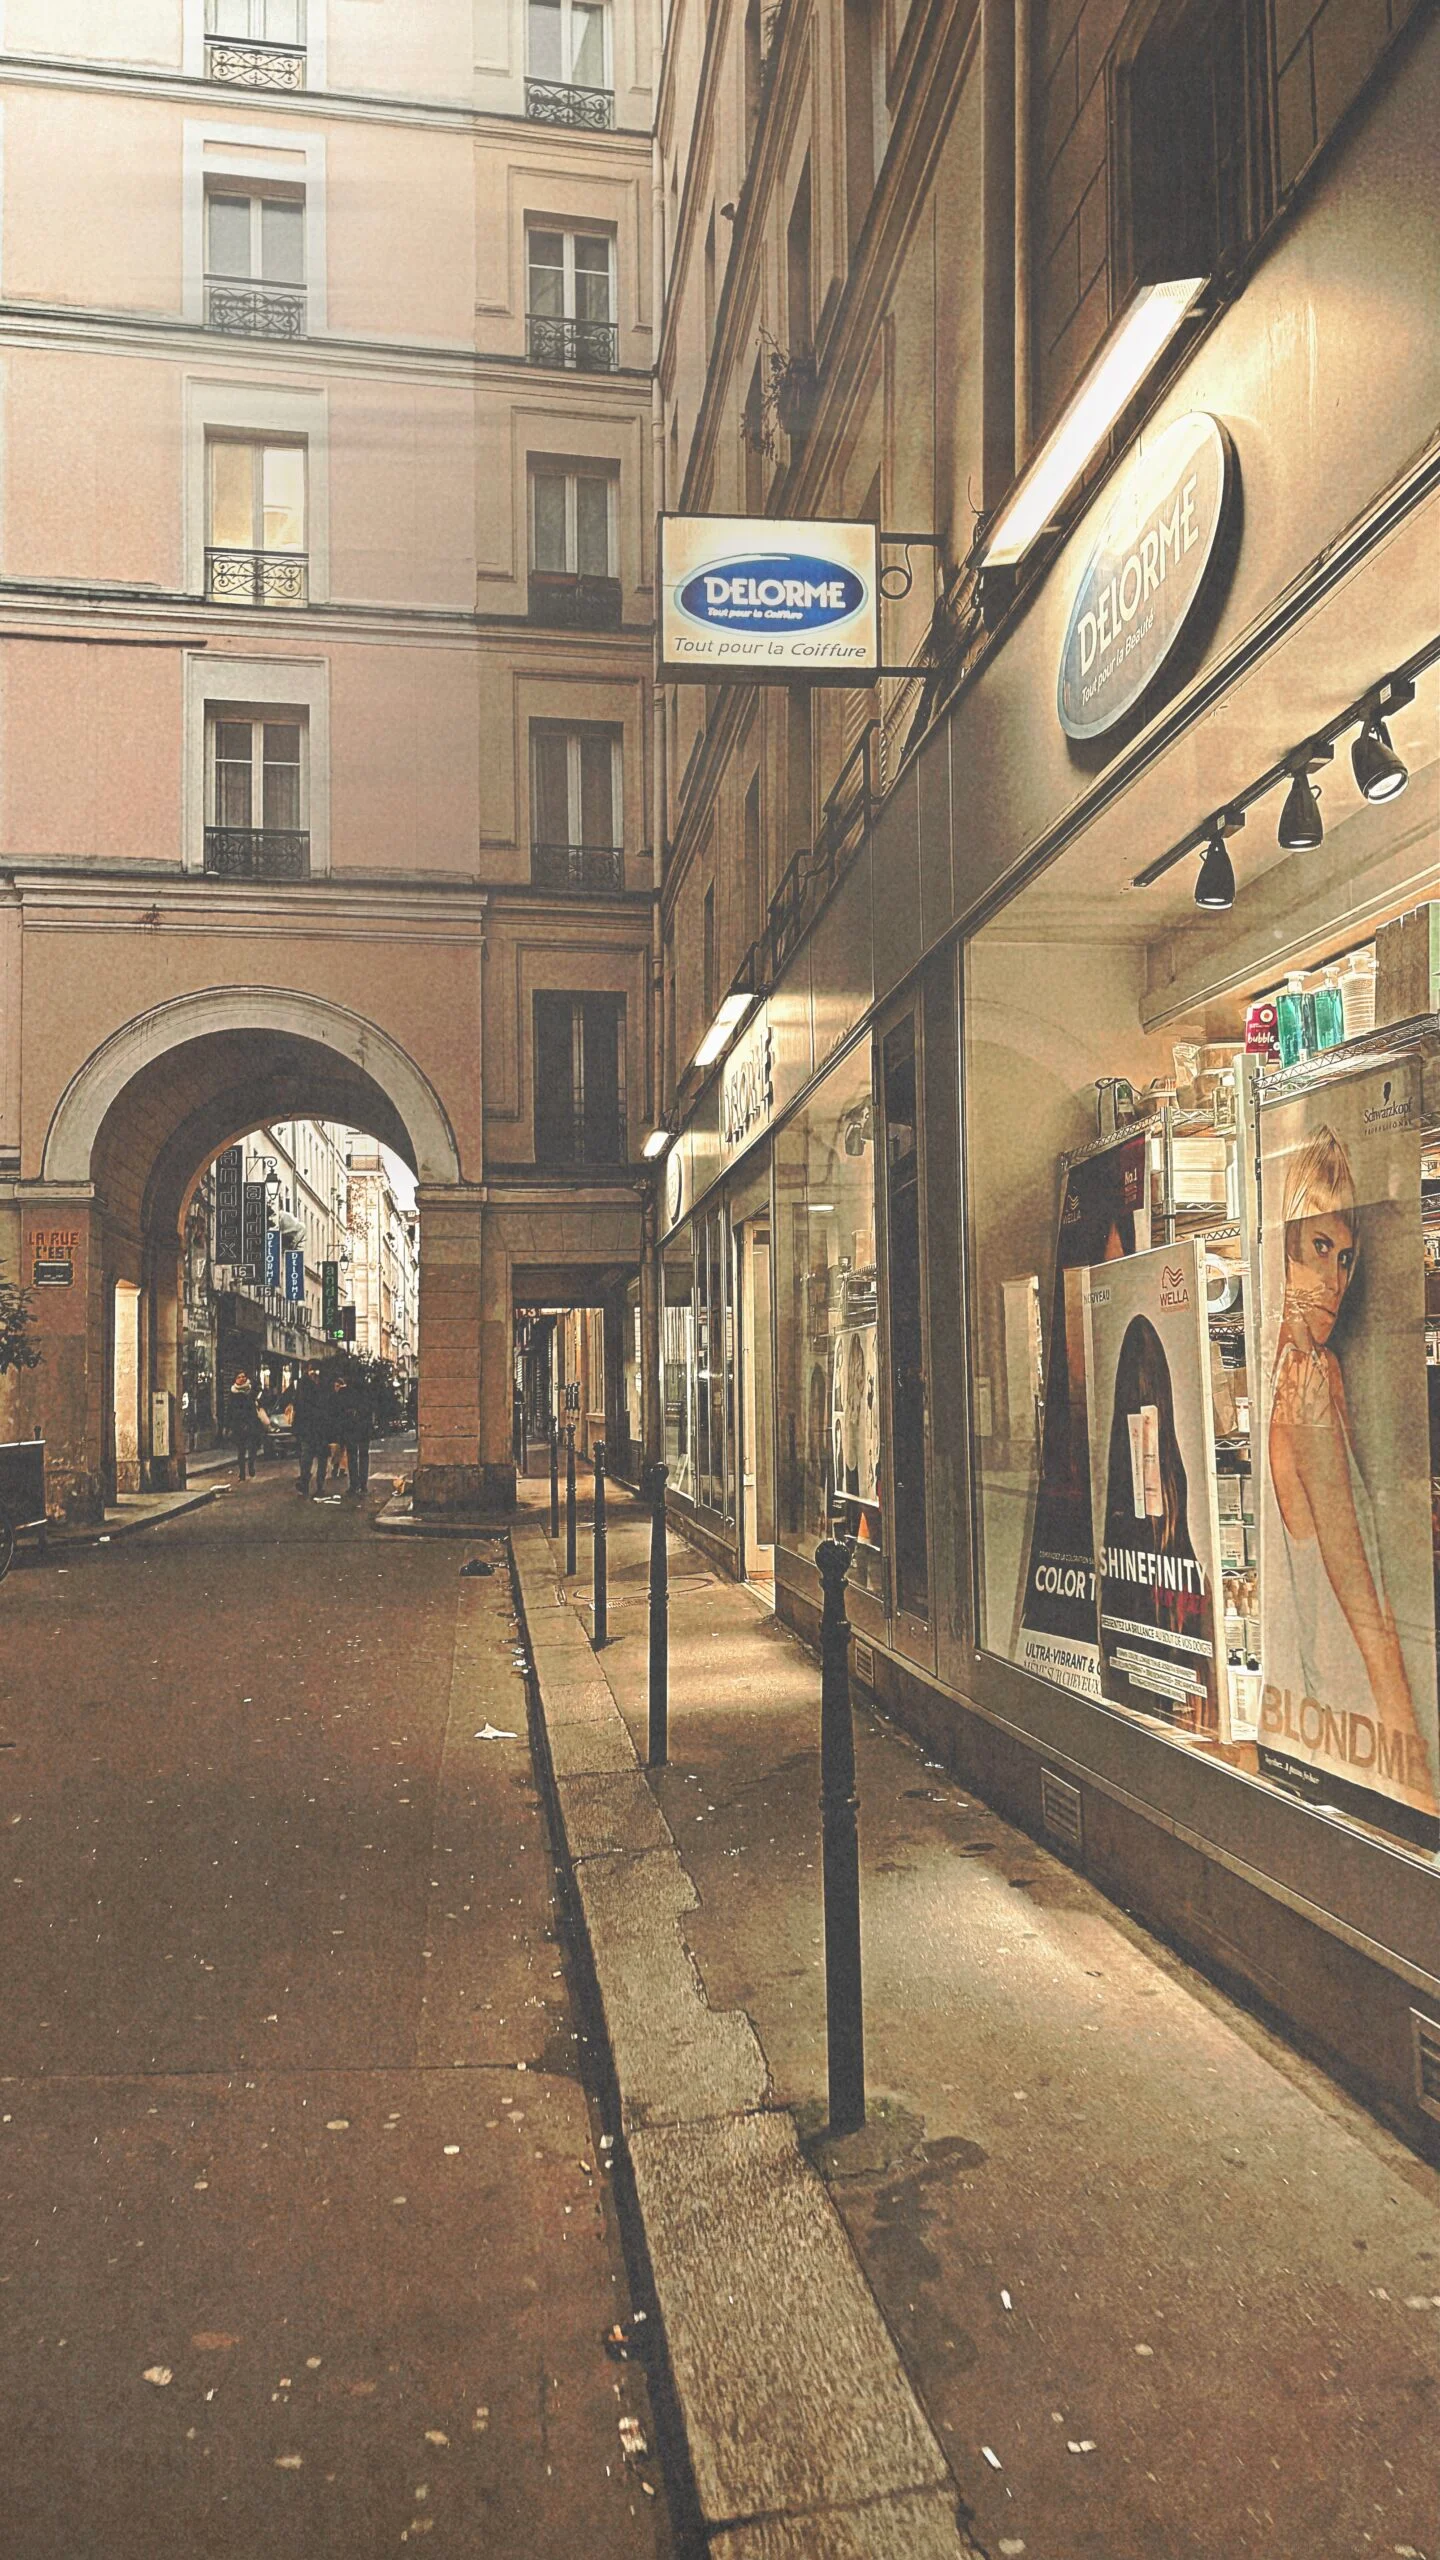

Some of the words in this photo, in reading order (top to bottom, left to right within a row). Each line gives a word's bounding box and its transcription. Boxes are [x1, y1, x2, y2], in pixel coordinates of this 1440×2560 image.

[1078, 473, 1199, 677] DELORME
[704, 577, 846, 608] DELORME
[708, 607, 728, 617] Tout
[728, 608, 752, 619] pour
[753, 608, 763, 618] la
[764, 609, 803, 620] Coiffure
[674, 637, 713, 653] Tout
[718, 642, 763, 656] pour
[767, 642, 784, 655] la
[791, 642, 867, 658] Coiffure
[1082, 676, 1097, 706] Tout
[1098, 657, 1115, 693] pour
[1116, 649, 1124, 666] la
[1125, 608, 1155, 656] Beauté
[1247, 1032, 1275, 1044] bubble
[1363, 1096, 1413, 1124] Schwarzkopf
[29, 1231, 45, 1245] LA
[50, 1231, 79, 1245] RUE
[233, 1266, 247, 1277] 16
[259, 1287, 272, 1297] 16
[326, 1266, 335, 1325] andrex
[1159, 1288, 1190, 1307] WELLA
[1035, 1565, 1085, 1599] COLOR
[1100, 1545, 1209, 1596] SHINEFINITY
[1025, 1642, 1088, 1672] ULTRA-VIBRANT
[1088, 1658, 1095, 1673] &
[1262, 1684, 1429, 1792] BLONDME
